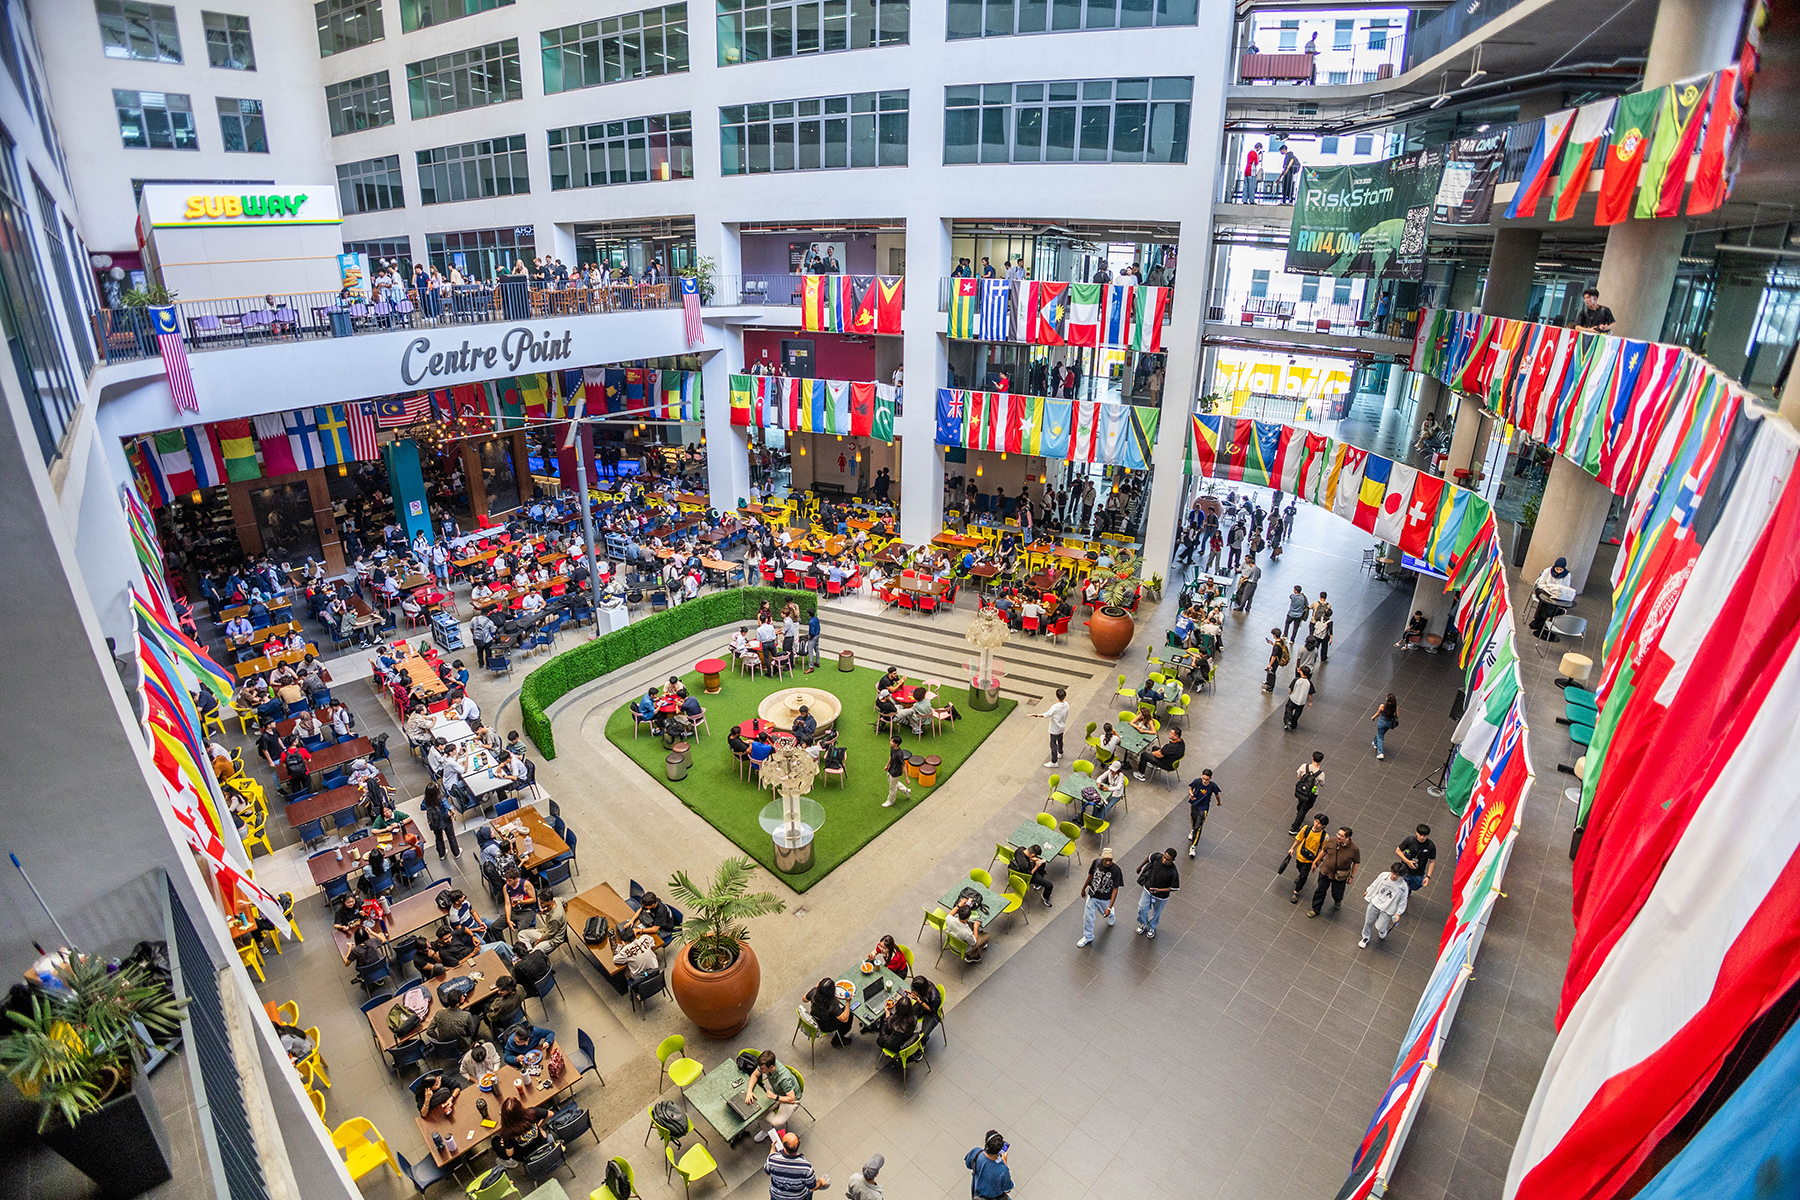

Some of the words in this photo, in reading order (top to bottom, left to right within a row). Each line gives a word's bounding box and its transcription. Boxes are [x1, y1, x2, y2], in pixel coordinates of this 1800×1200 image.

[184, 193, 309, 219] SUBWAY
[1305, 187, 1394, 207] RiskStorm
[1297, 231, 1360, 256] RM4,000
[401, 337, 498, 385] Centre
[502, 327, 572, 371] Point
